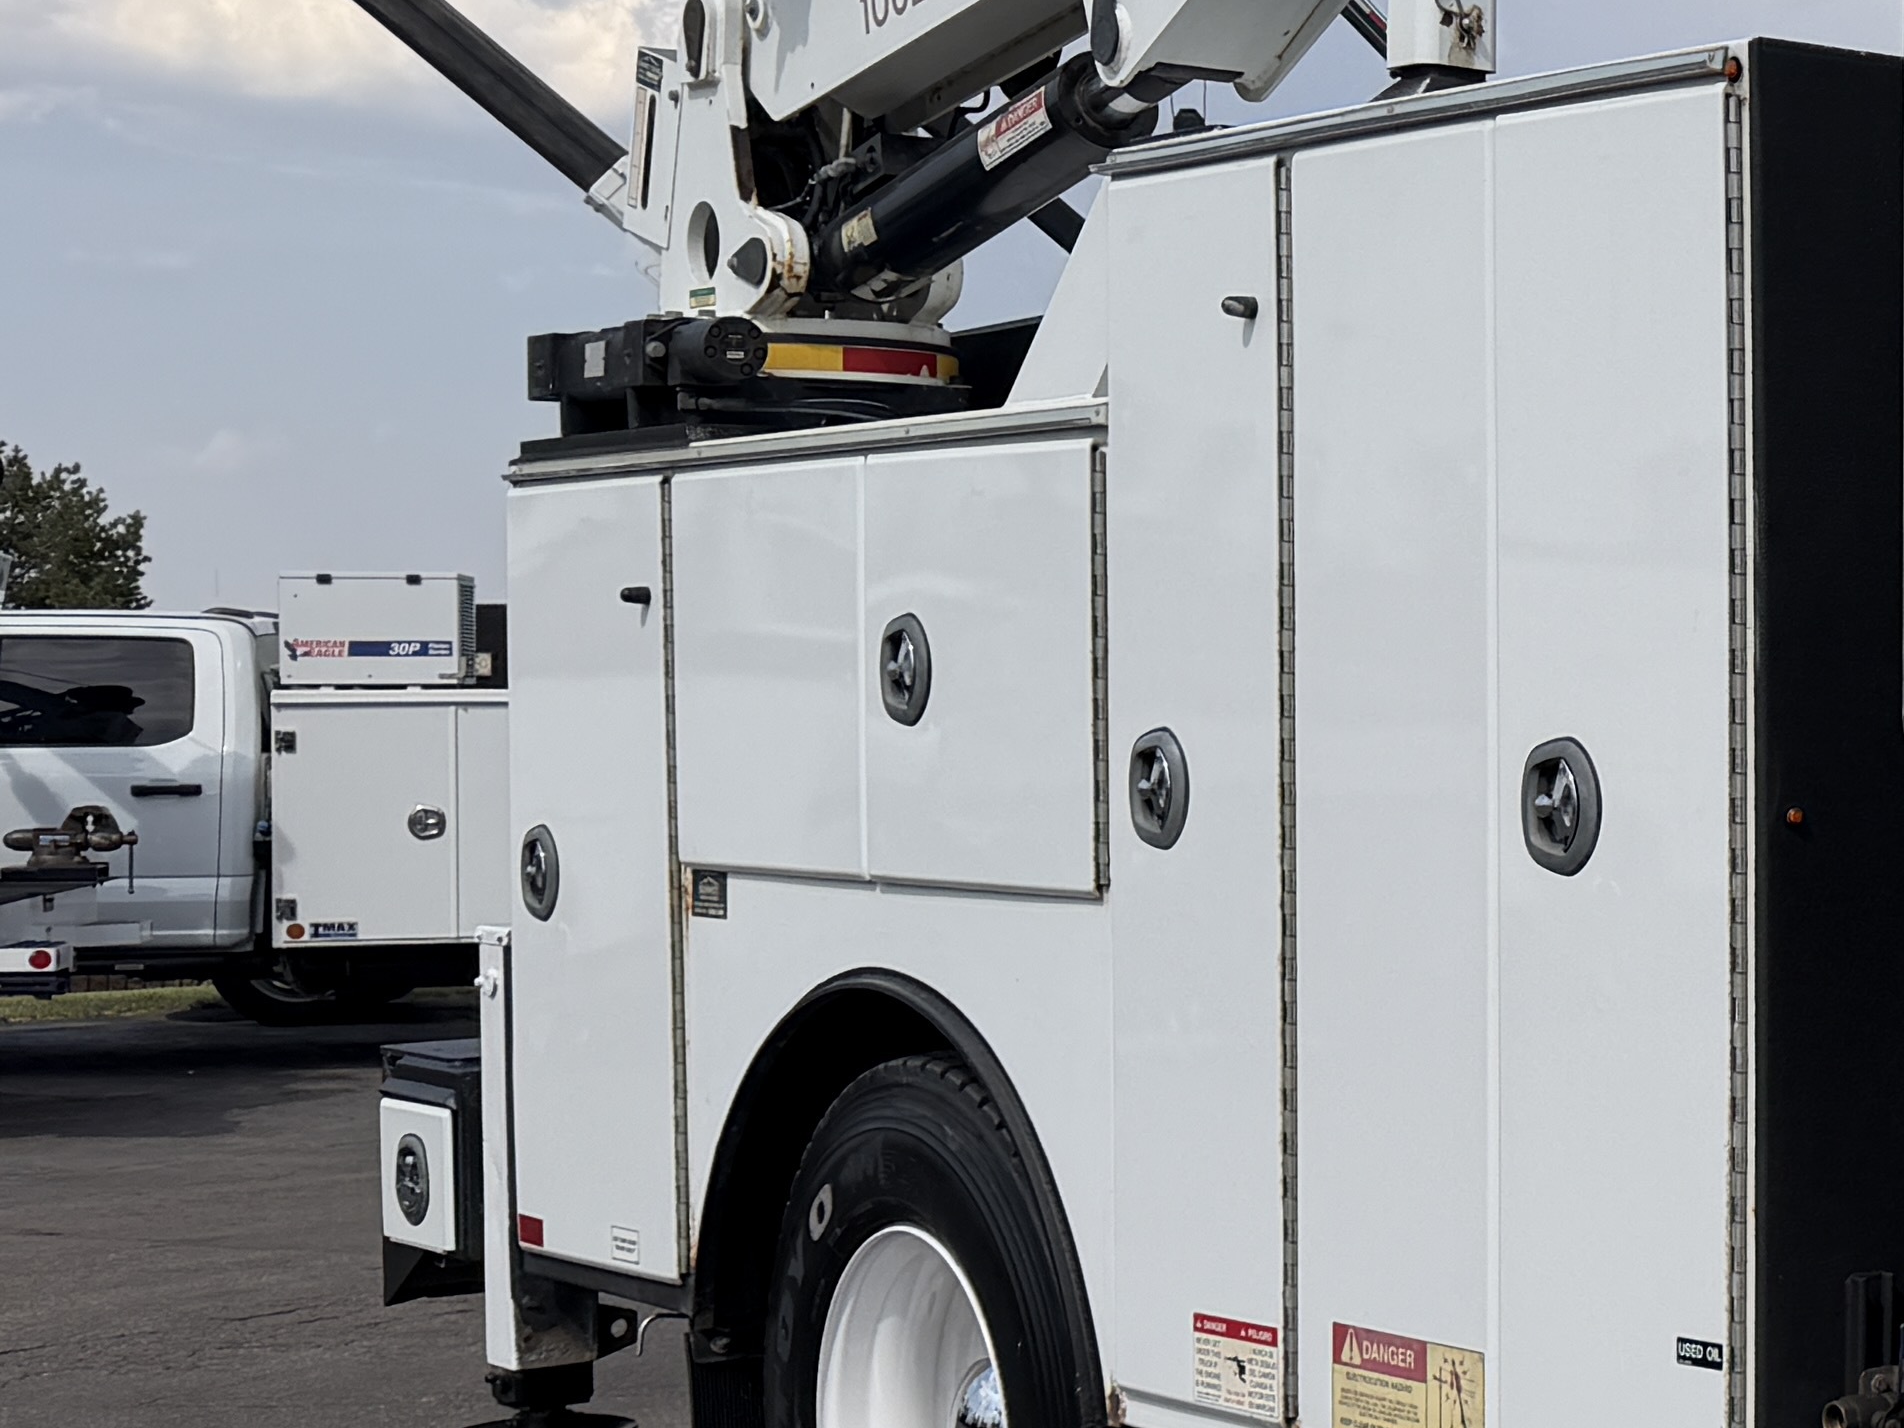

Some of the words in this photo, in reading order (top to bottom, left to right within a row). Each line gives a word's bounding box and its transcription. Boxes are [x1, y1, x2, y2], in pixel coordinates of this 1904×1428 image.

[388, 642, 421, 656] 30P
[310, 922, 358, 938] TMAX
[1362, 1339, 1415, 1370] DANGER
[1678, 1340, 1704, 1359] USED
[1706, 1346, 1722, 1362] OIL
